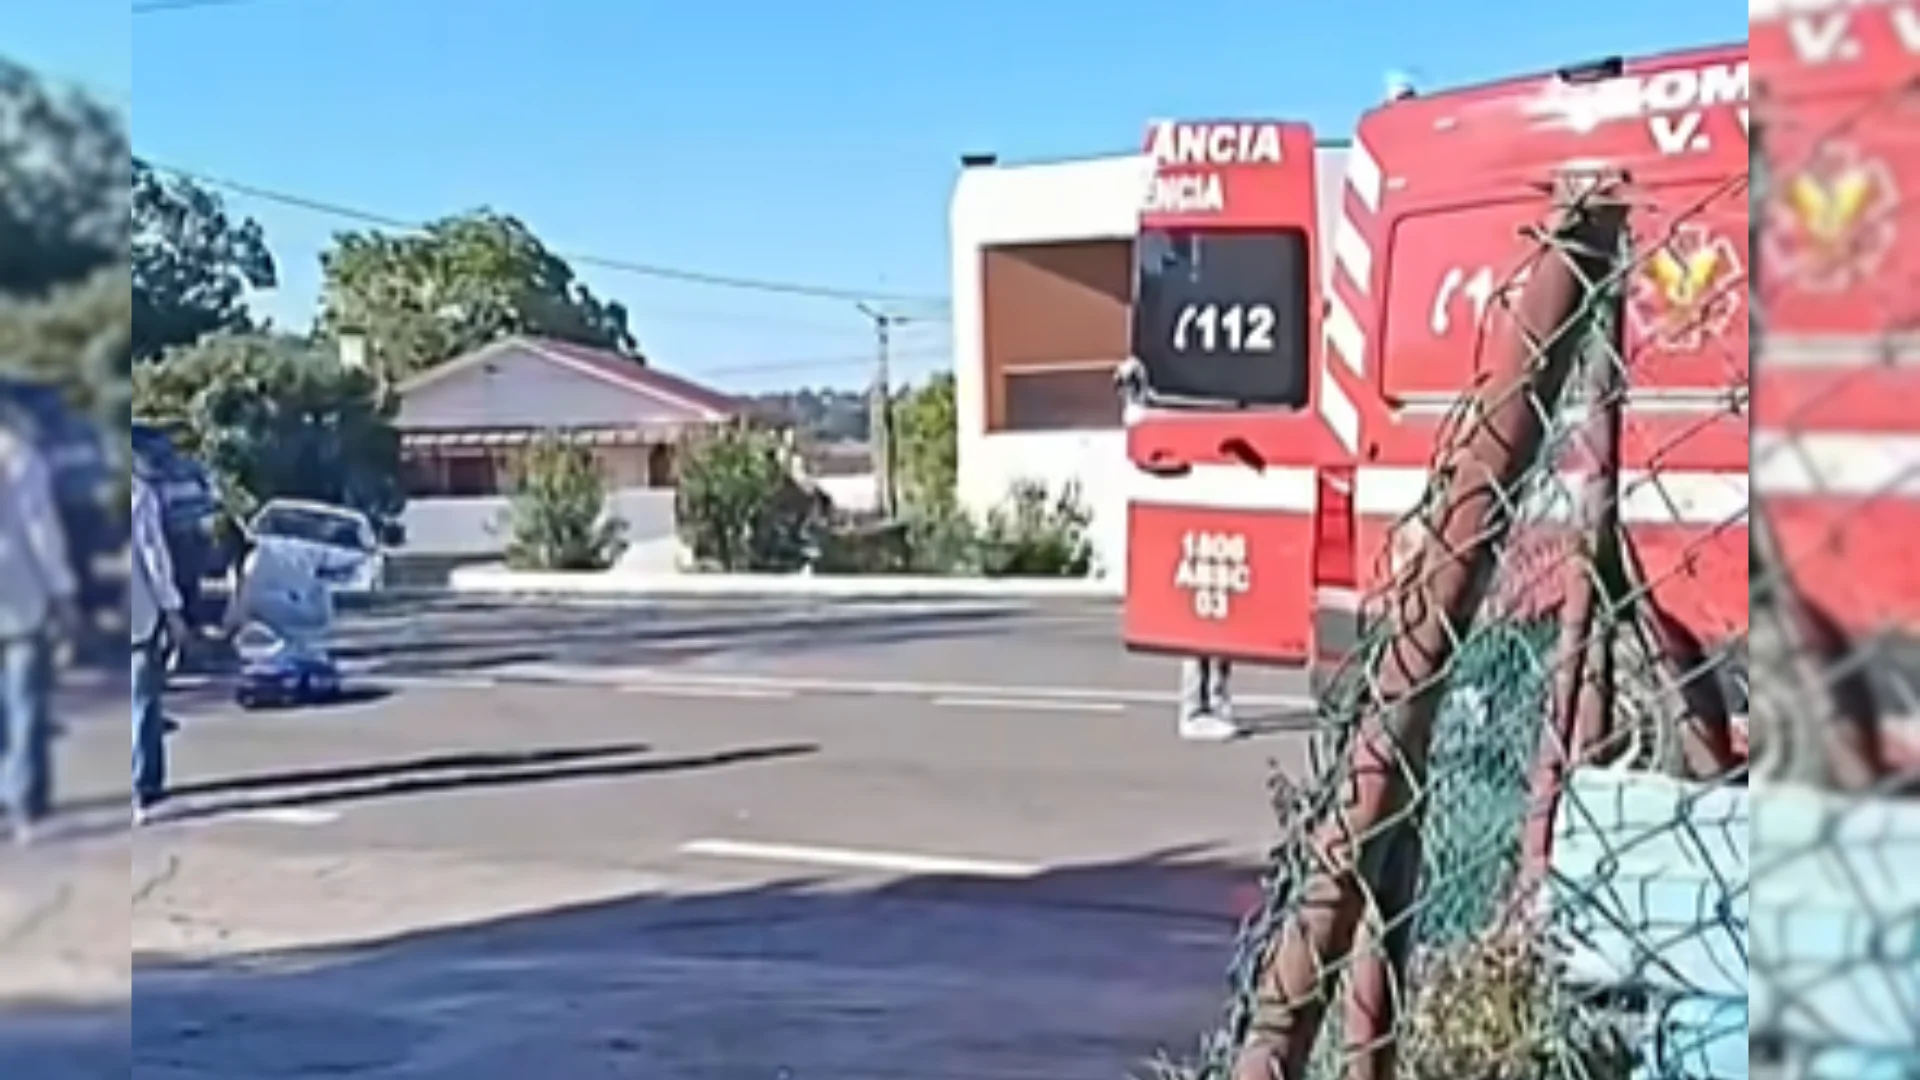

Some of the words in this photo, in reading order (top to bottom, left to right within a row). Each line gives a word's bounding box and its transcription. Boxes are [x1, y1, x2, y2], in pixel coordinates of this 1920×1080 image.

[1614, 64, 1749, 120] OM
[1650, 112, 1710, 154] V.
[1196, 303, 1276, 351] 112
